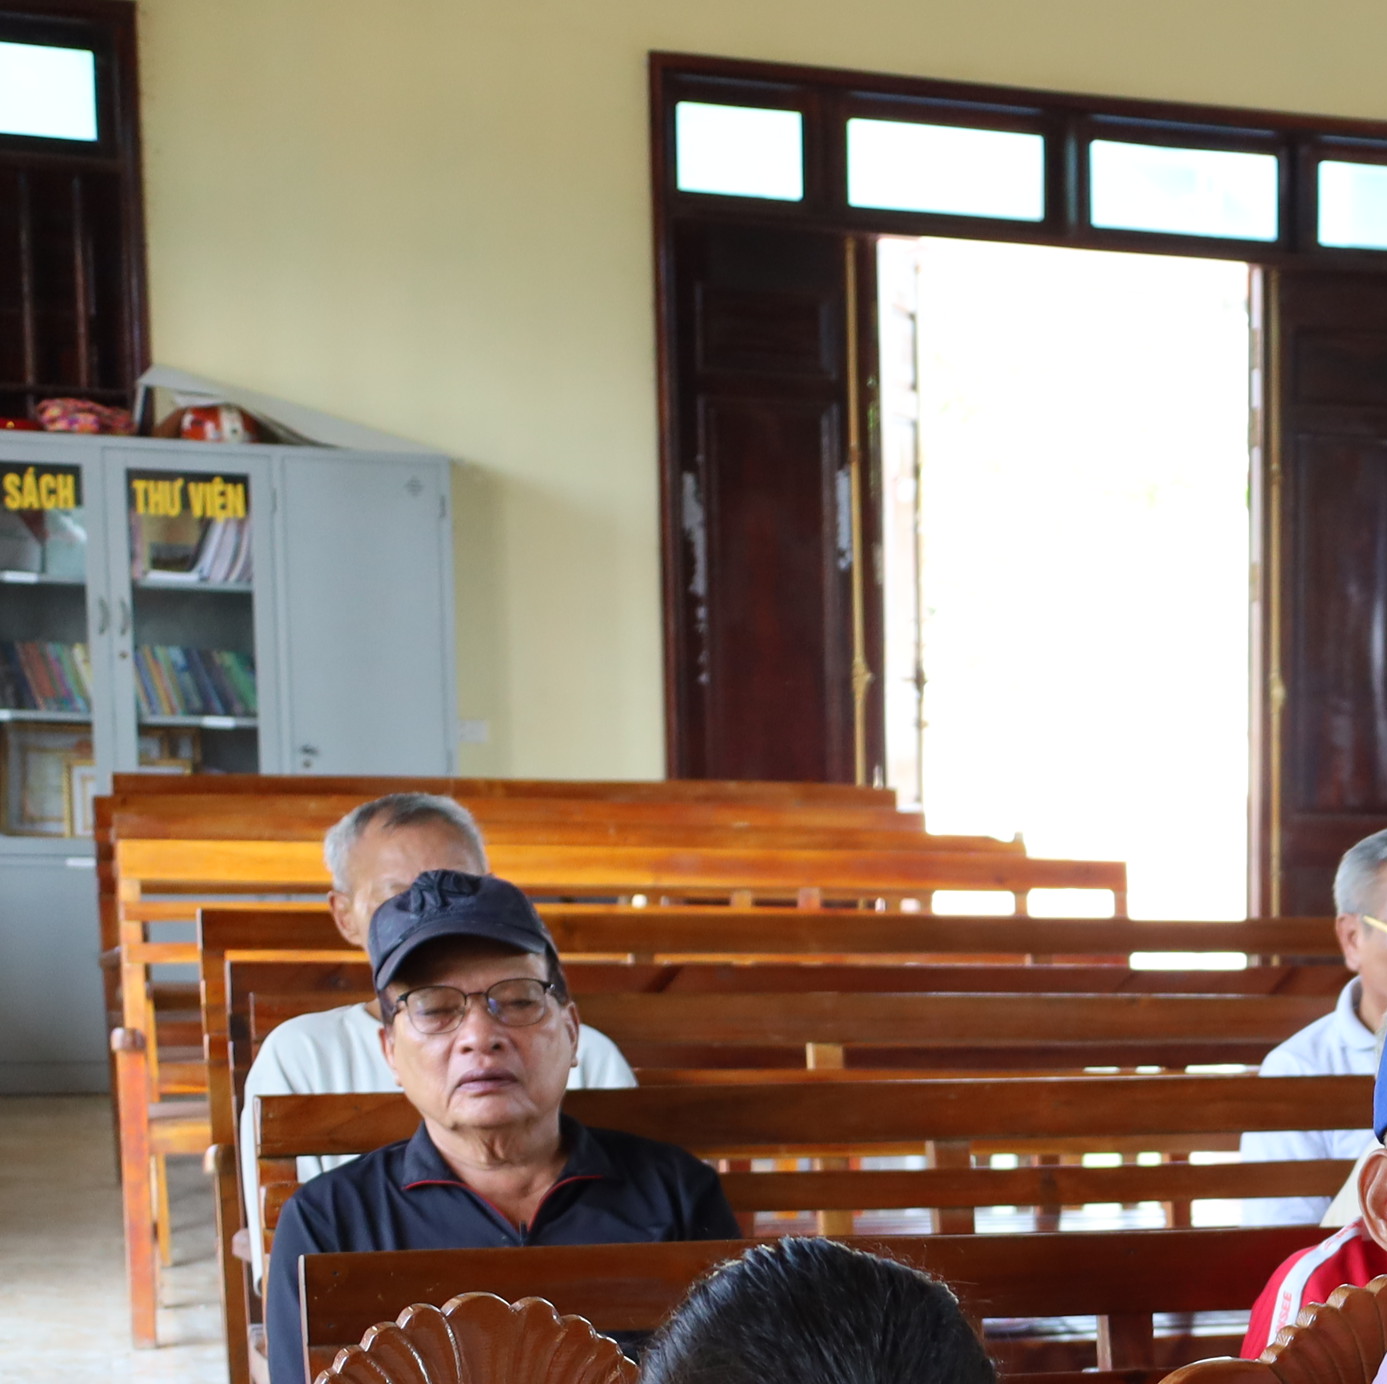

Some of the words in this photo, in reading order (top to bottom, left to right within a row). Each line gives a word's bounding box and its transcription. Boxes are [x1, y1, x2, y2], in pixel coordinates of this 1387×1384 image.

[3, 466, 75, 510] SÁCH
[132, 477, 184, 516] THƯ
[188, 476, 246, 522] VIỆN
[1276, 1291, 1292, 1332] NSEE
